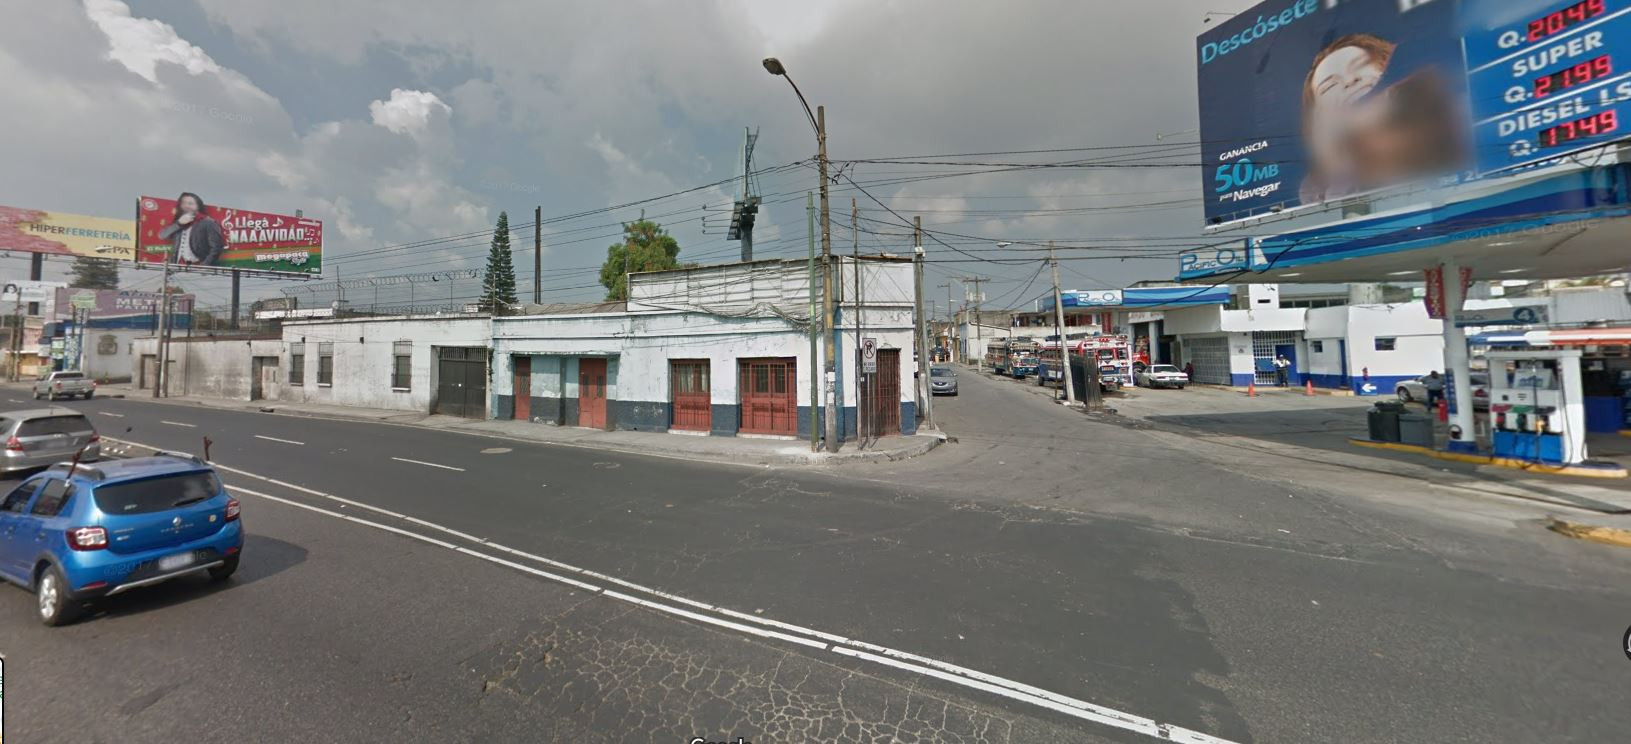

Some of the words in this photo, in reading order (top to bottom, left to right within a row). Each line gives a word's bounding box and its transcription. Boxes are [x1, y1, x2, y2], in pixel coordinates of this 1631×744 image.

[1201, 0, 1319, 65] Descósete
[1512, 31, 1604, 77] SUPER
[1499, 97, 1590, 137] DIESEL
[1600, 81, 1631, 106] LS
[1219, 140, 1268, 161] GANANCIA
[1233, 182, 1282, 202] Navegar
